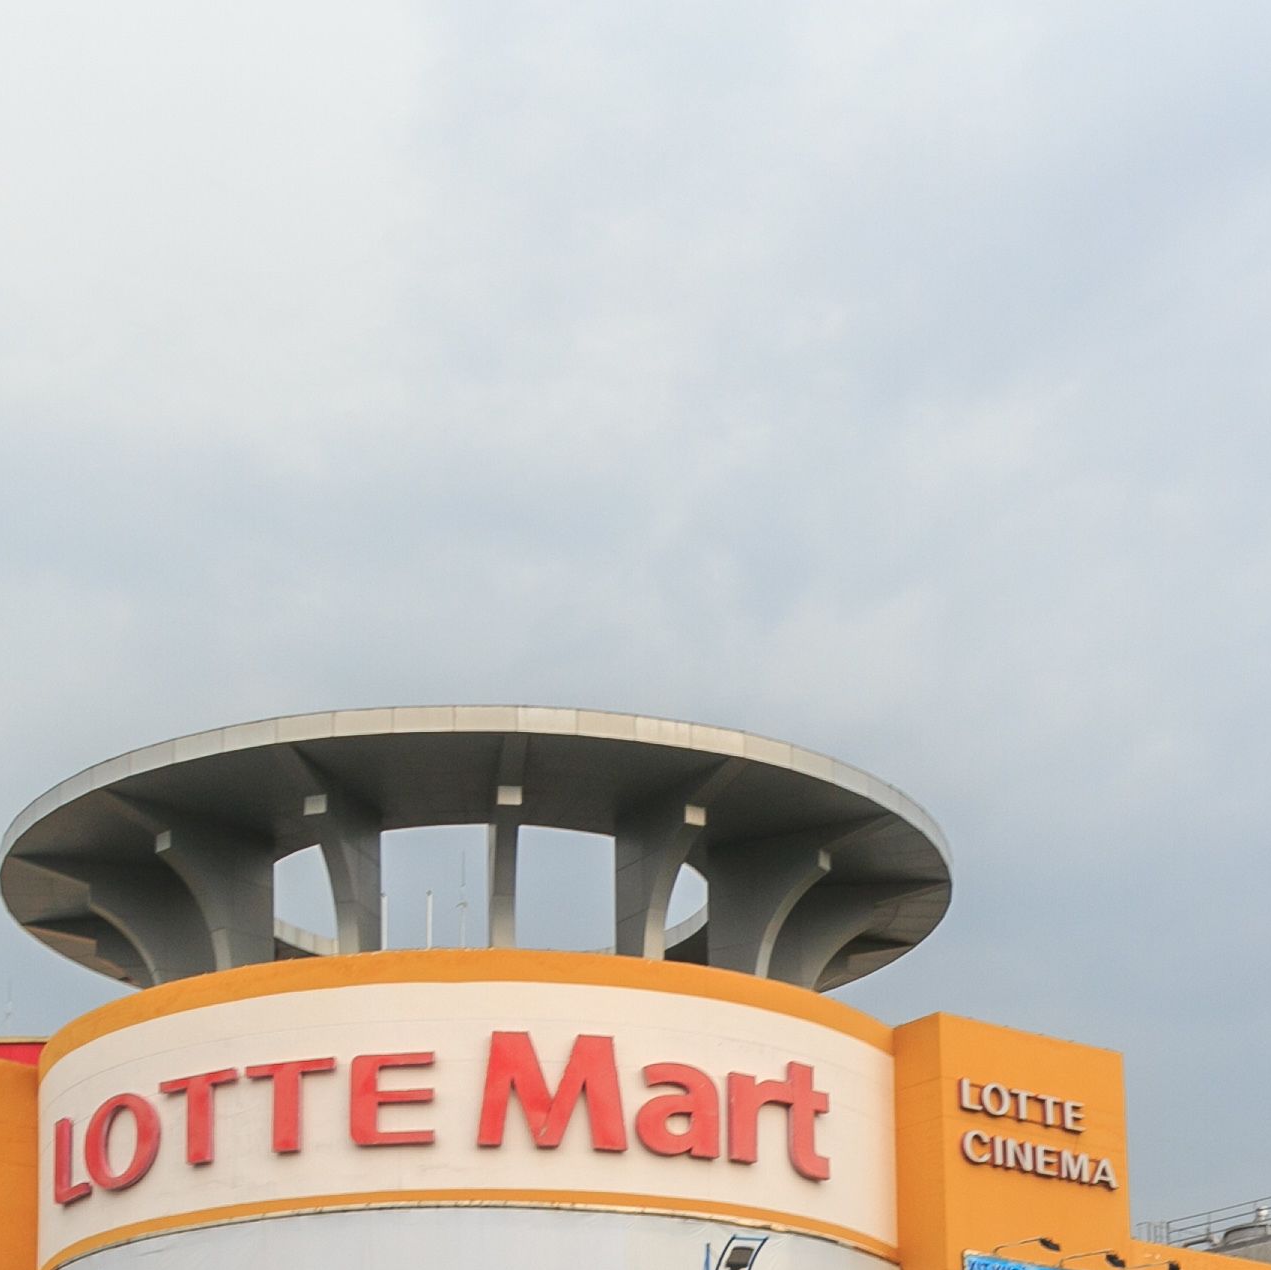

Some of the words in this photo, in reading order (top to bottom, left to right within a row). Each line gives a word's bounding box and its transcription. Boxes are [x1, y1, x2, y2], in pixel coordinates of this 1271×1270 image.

[52, 1051, 436, 1204] LOTTE
[477, 1031, 830, 1181] Mart
[958, 1076, 1086, 1134] LOTTE
[961, 1129, 1119, 1189] CINEMA
